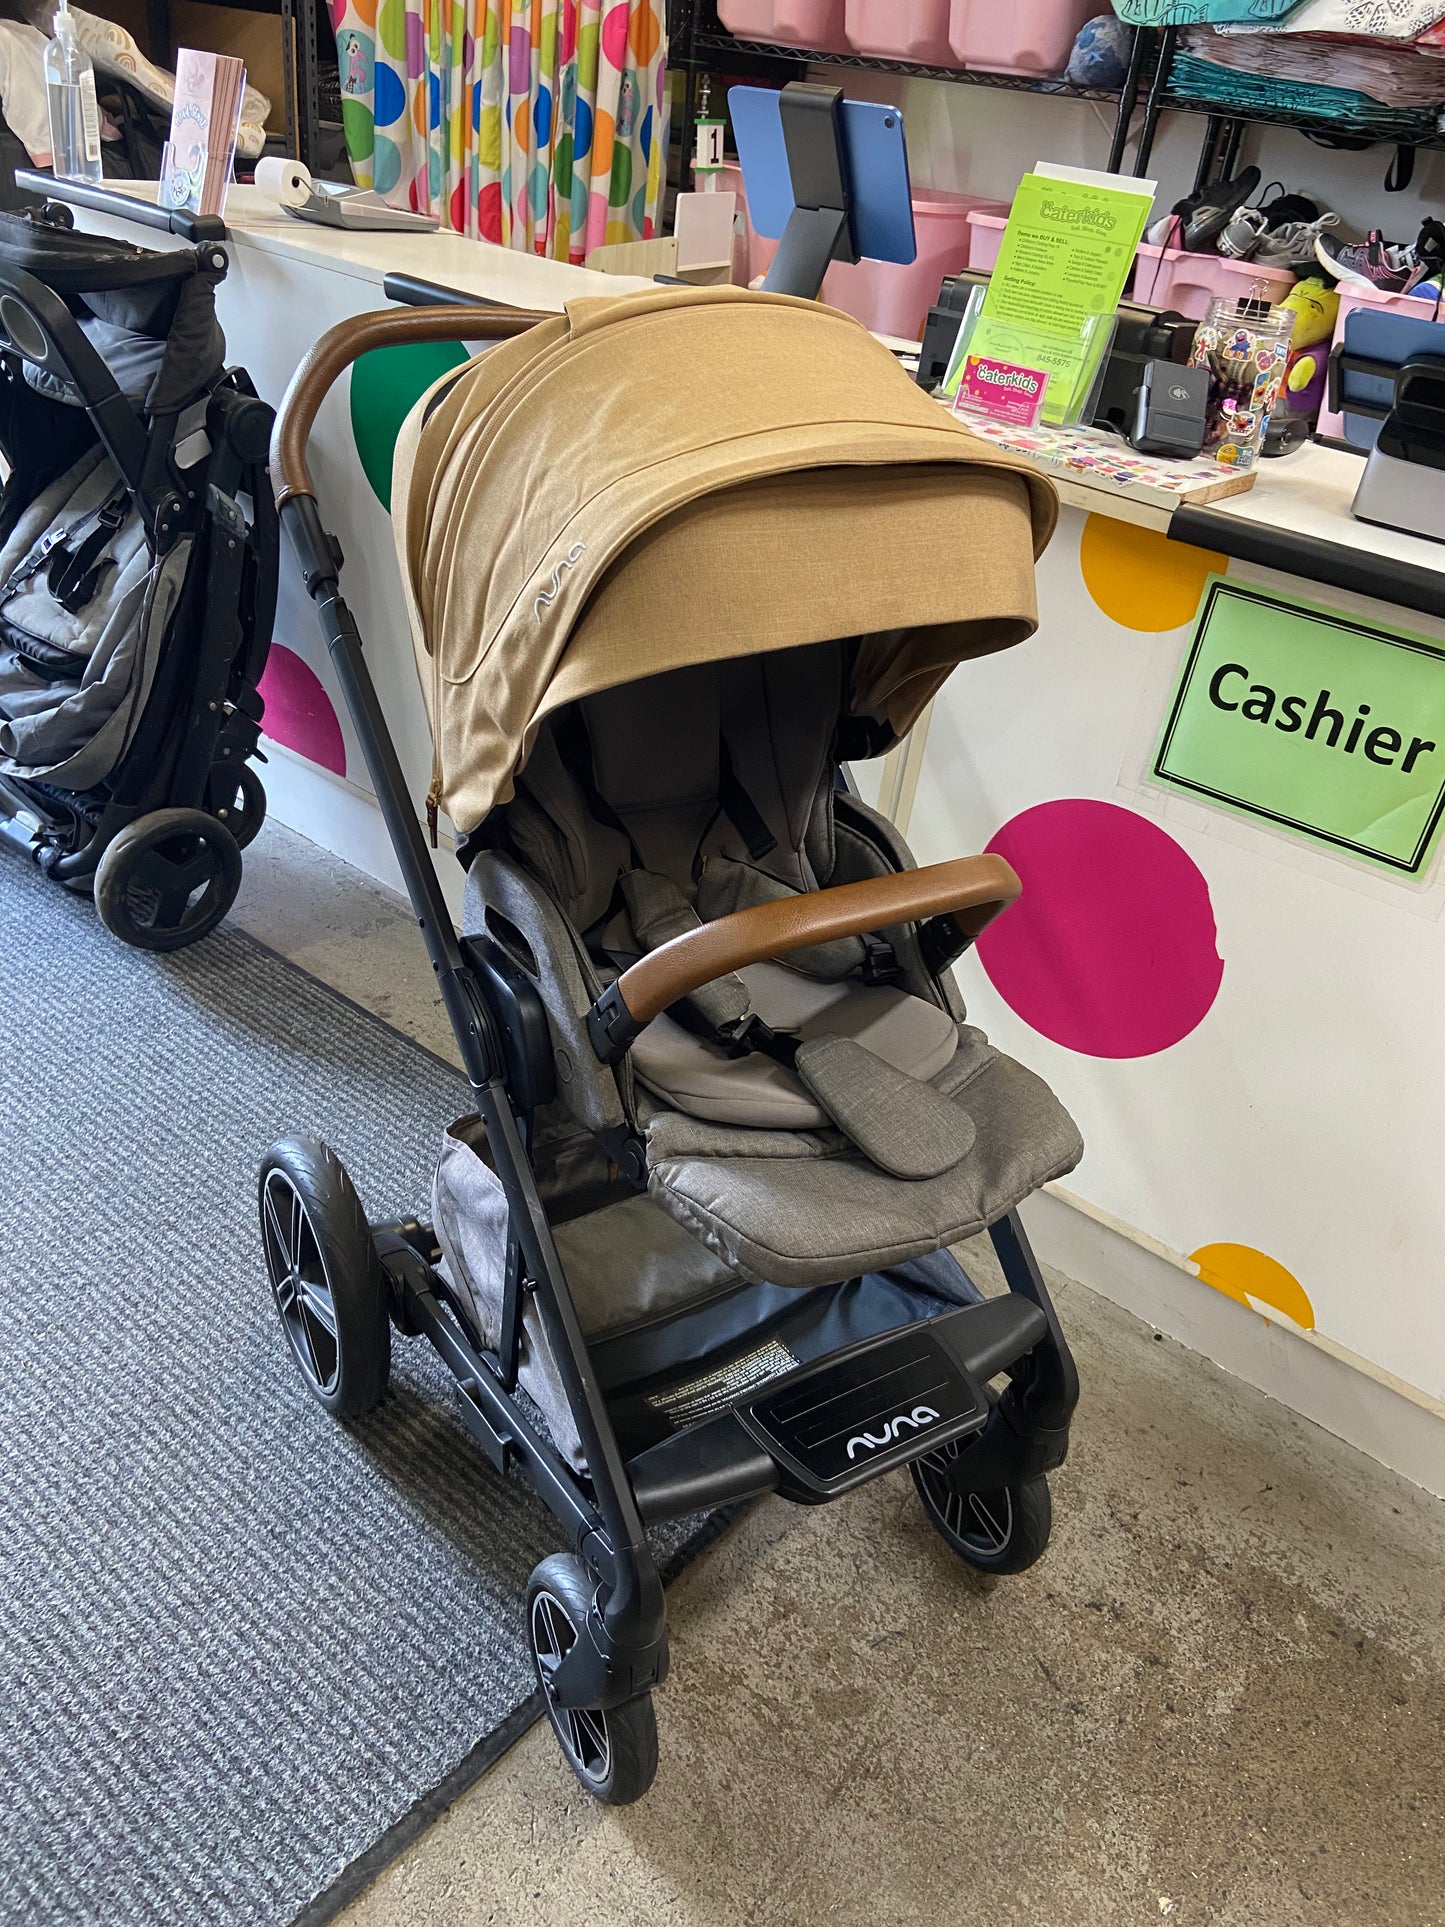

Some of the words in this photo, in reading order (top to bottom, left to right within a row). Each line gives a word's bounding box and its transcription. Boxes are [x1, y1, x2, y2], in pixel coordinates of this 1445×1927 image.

[710, 128, 720, 164] 1
[533, 541, 587, 624] nuna
[1208, 663, 1436, 773] Cashier
[846, 1405, 940, 1459] nuna
